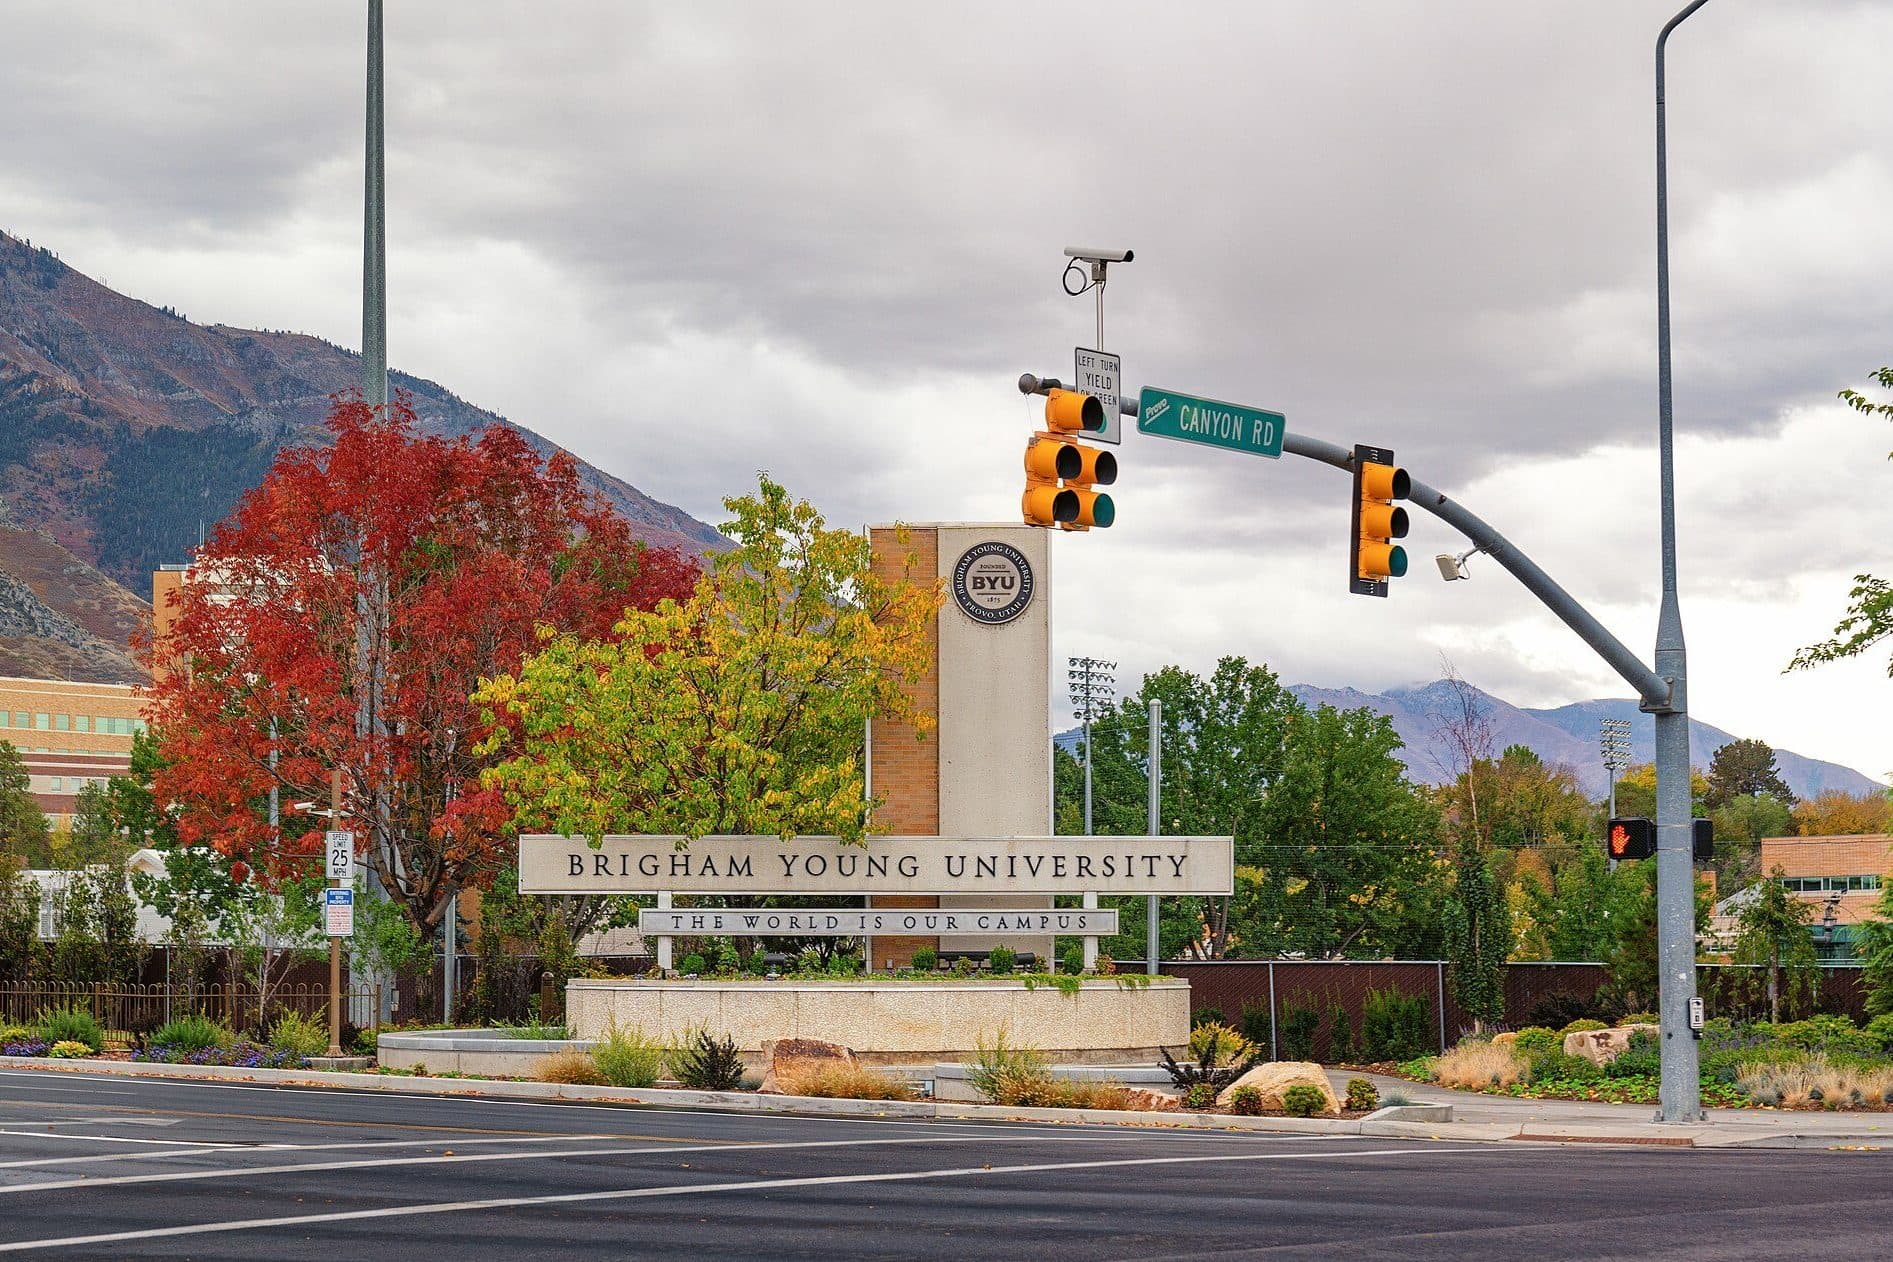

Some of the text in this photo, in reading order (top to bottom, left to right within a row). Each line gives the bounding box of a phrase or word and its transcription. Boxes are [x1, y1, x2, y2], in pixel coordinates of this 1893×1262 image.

[1078, 354, 1118, 372] LEFT TURN
[1085, 372, 1112, 390] YIELD
[1145, 398, 1168, 419] Provo
[1180, 404, 1274, 446] CANYON RD
[956, 544, 1031, 595] BRIGHAM YOUNG UNIVERSITY
[972, 576, 1015, 590] BYU
[999, 601, 1022, 618] UTAH
[332, 833, 348, 841] SPEED
[332, 849, 348, 867] 25
[567, 854, 1189, 879] BRIGHAM YOUNG UNIVERSITY
[333, 867, 347, 877] MPH
[671, 915, 1088, 930] THE WORLD IS OUR CAMPUS
